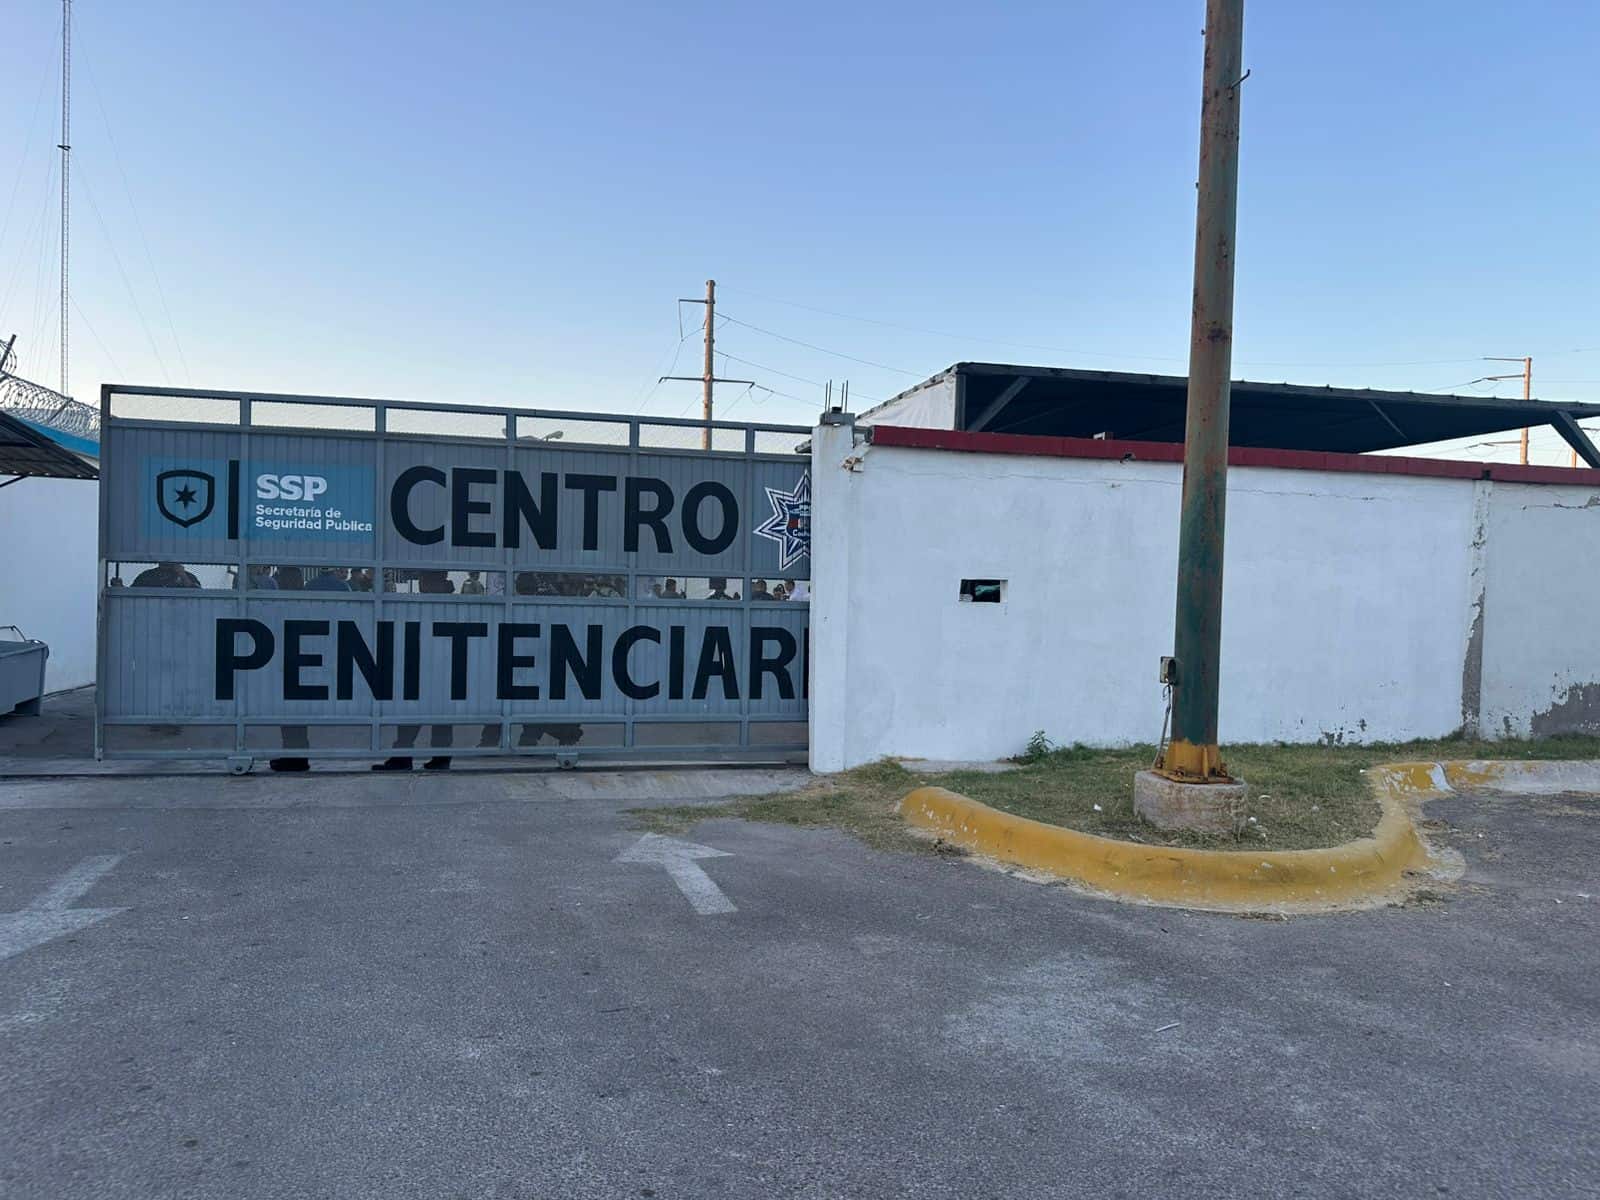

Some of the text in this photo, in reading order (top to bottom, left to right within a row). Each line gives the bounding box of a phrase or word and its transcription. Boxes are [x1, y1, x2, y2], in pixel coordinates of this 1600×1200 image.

[256, 474, 328, 501] SSP
[325, 507, 342, 518] de
[390, 465, 739, 557] CENTRO
[255, 516, 322, 530] Seguridad
